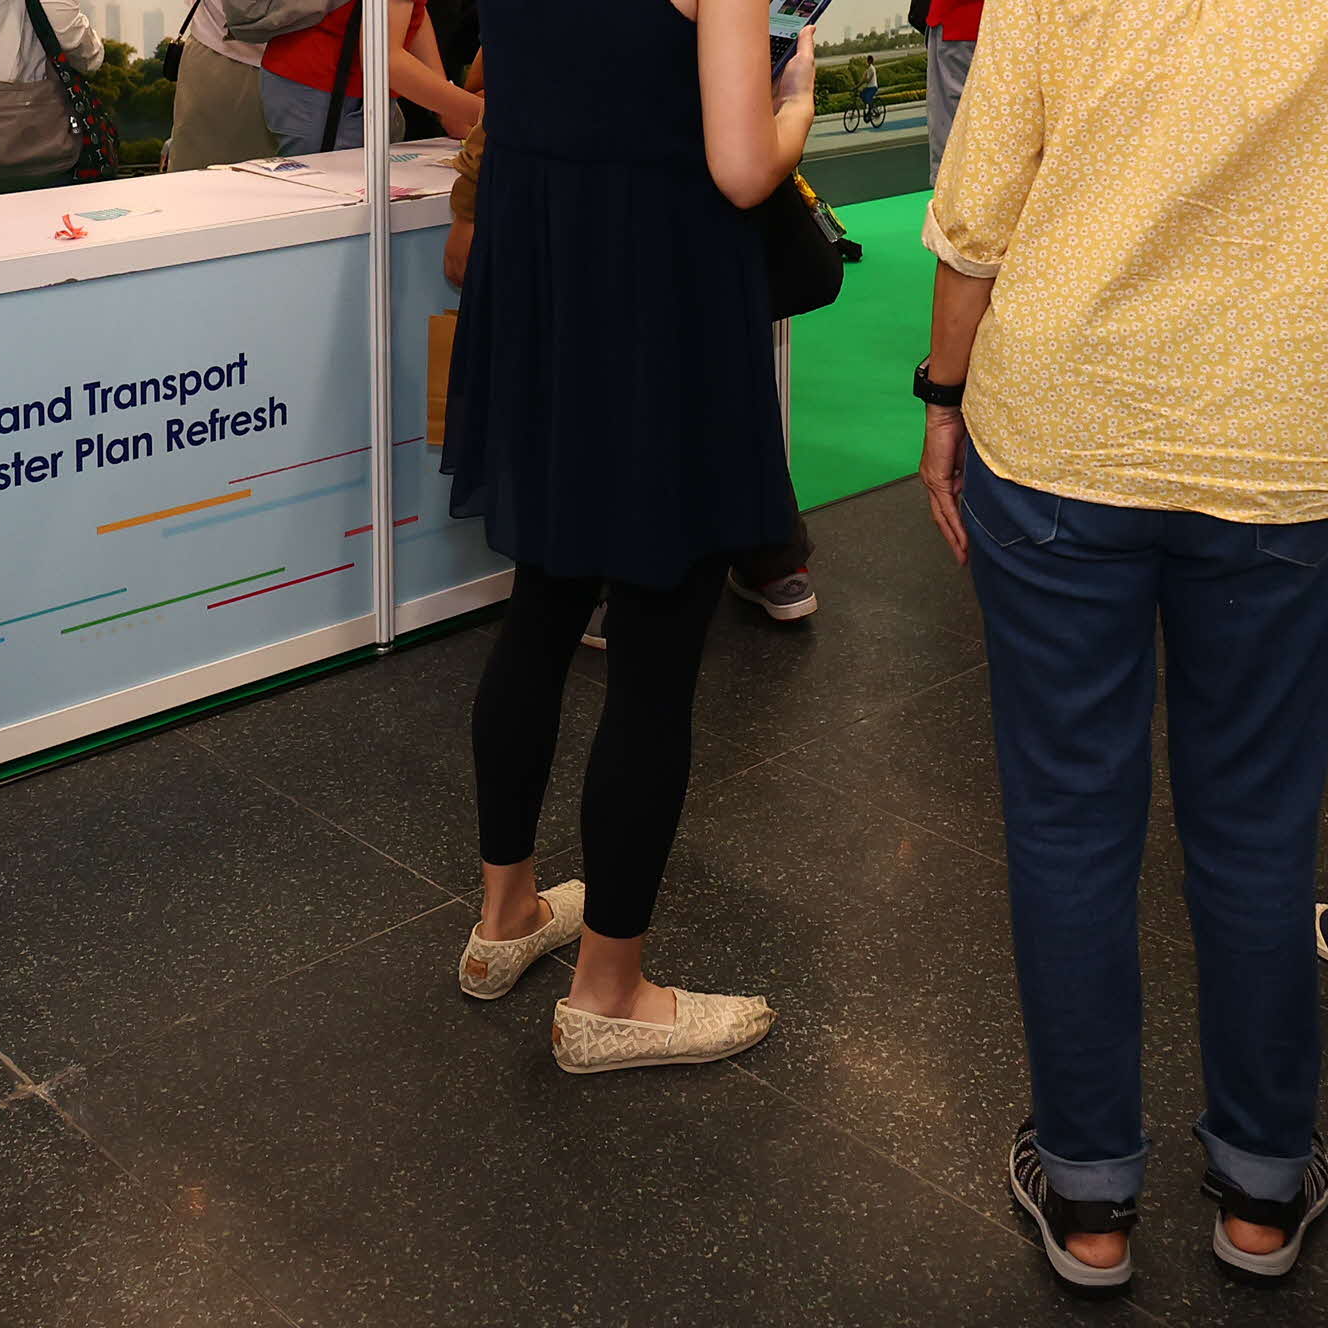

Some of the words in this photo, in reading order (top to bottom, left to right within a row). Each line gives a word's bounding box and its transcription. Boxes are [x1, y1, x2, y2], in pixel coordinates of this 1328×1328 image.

[83, 353, 248, 417] Transport
[75, 433, 153, 473] Plan
[166, 397, 287, 453] Refresh
